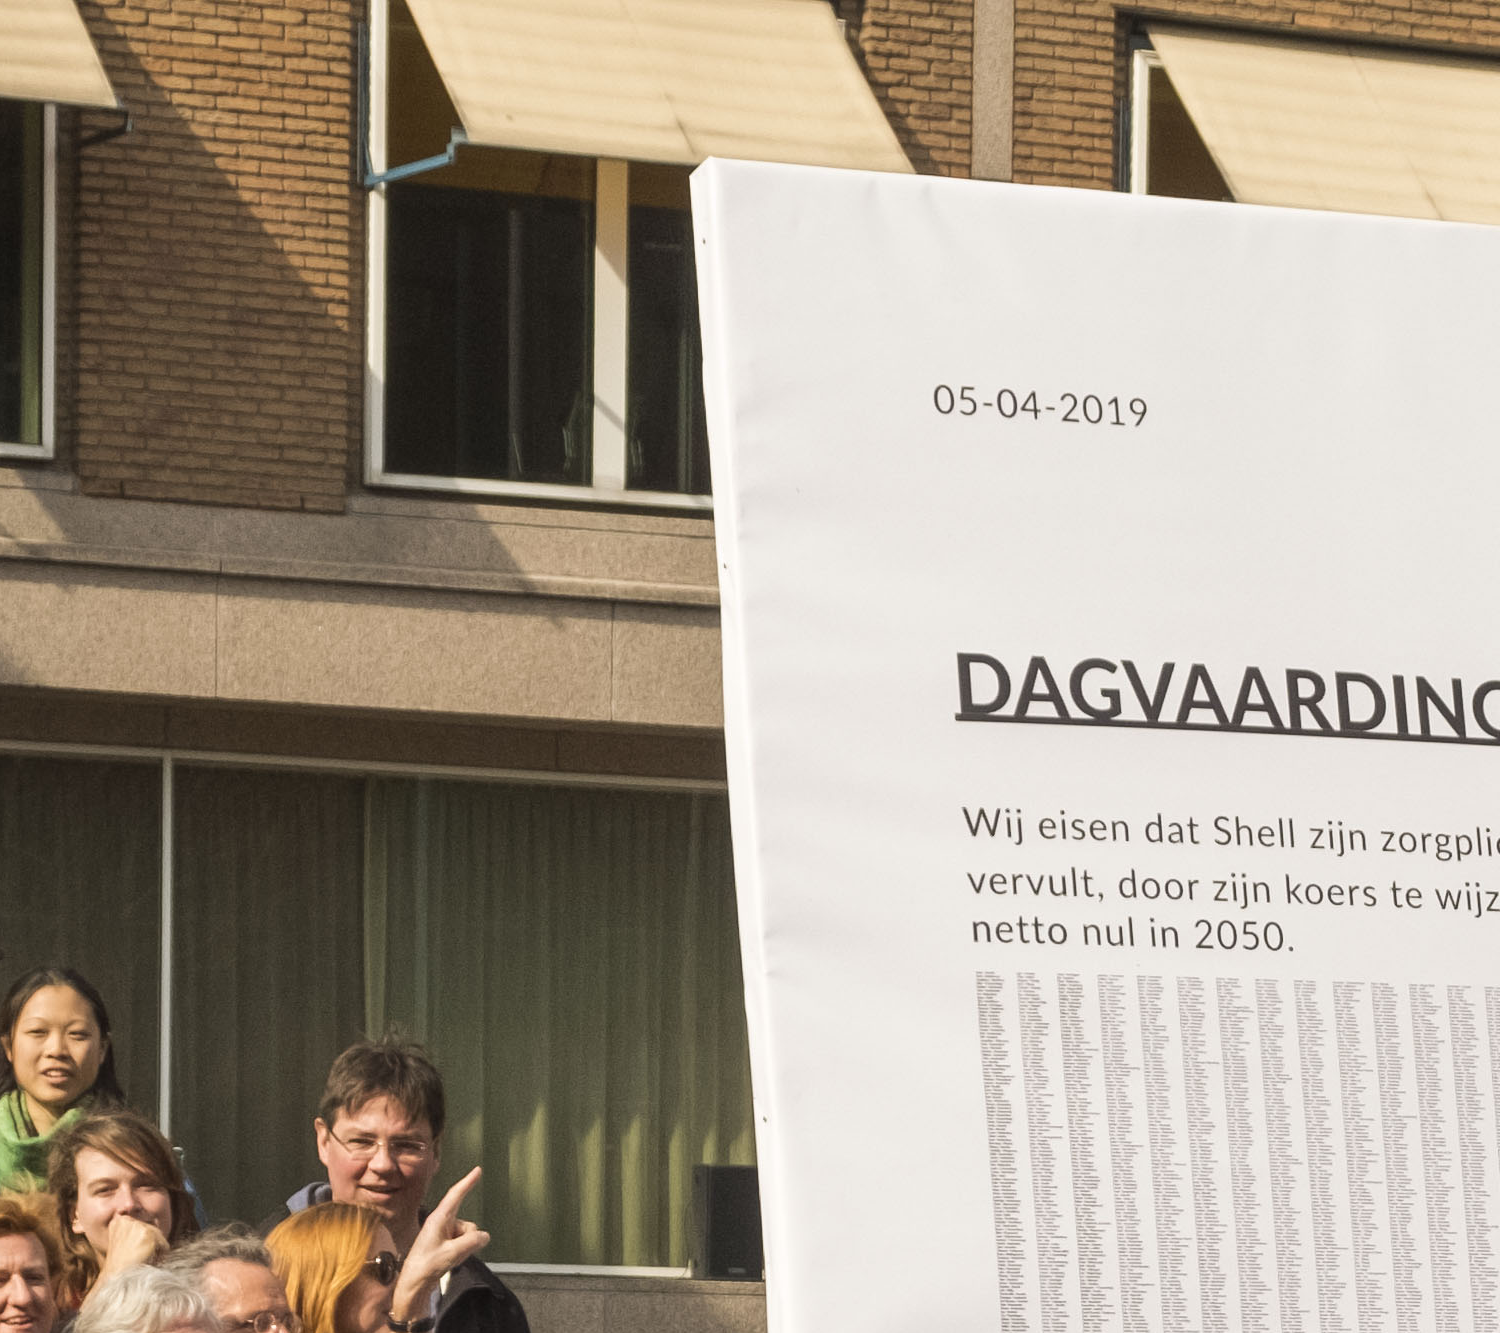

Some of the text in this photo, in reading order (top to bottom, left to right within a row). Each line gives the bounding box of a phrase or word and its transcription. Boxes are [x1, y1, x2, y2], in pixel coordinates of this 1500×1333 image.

[934, 385, 1147, 426] 05-04-2019
[963, 807, 1022, 845] Wij
[1039, 810, 1129, 841] eisen
[1145, 813, 1199, 844] dat
[1214, 816, 1294, 847] Shell
[1310, 821, 1366, 856] zijn
[968, 867, 1103, 901] vervult,
[1119, 869, 1198, 900] door
[1213, 873, 1270, 909] zijn
[1286, 874, 1376, 906] koers
[1392, 881, 1422, 908] te
[973, 916, 1293, 951] netto nul in 2050.
